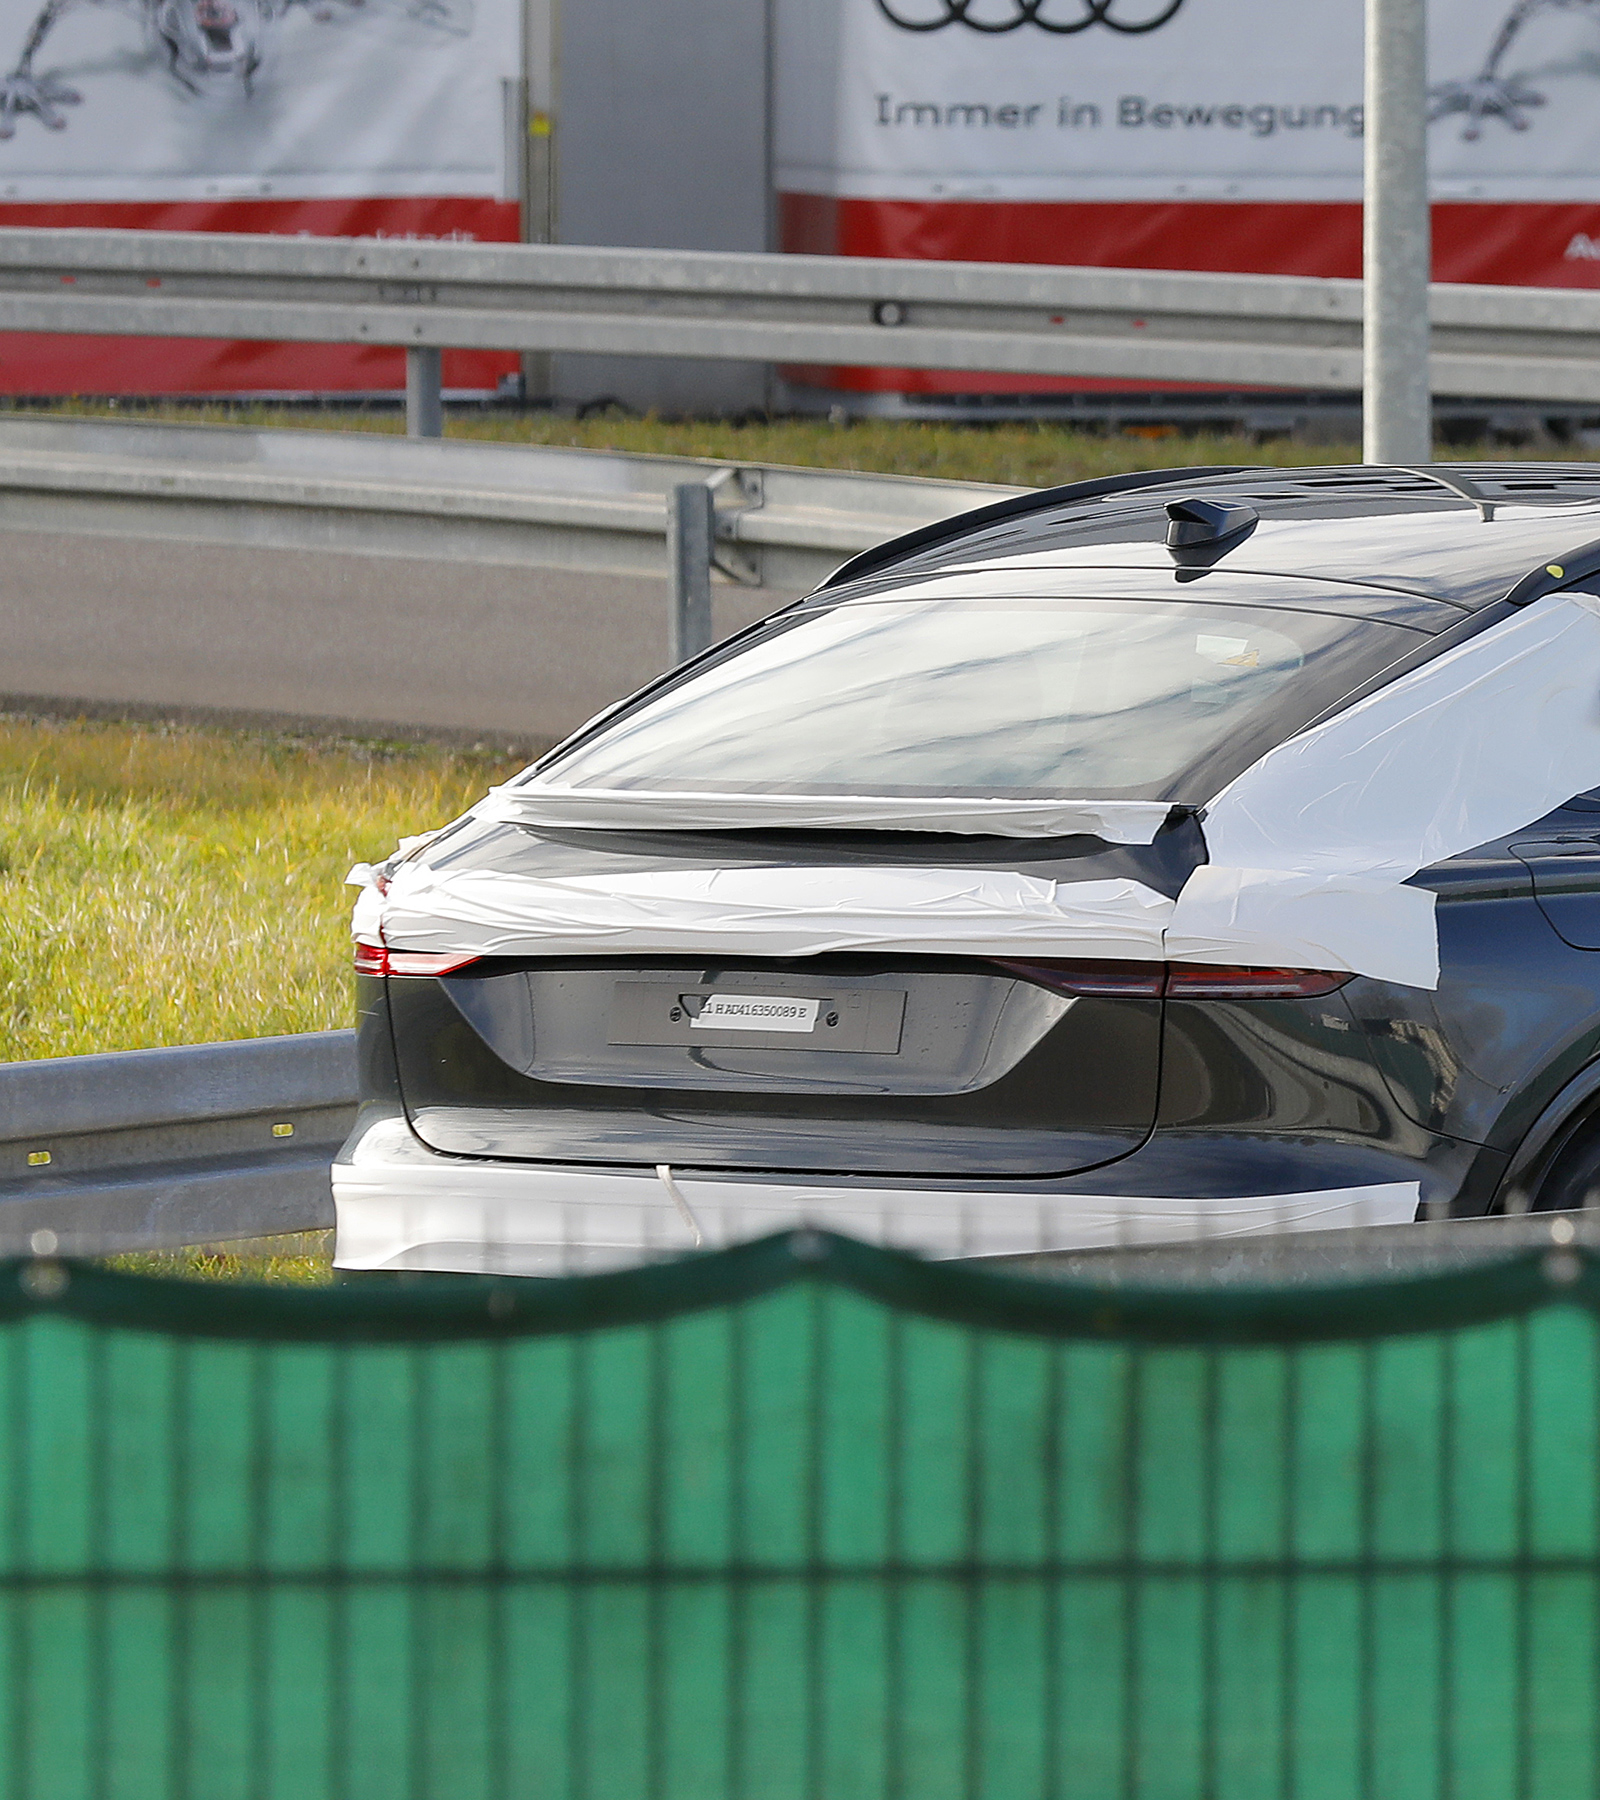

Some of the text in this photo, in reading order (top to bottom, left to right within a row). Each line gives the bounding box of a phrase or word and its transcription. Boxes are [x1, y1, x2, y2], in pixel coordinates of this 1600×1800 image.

[875, 92, 1364, 138] Immer in Bewegung
